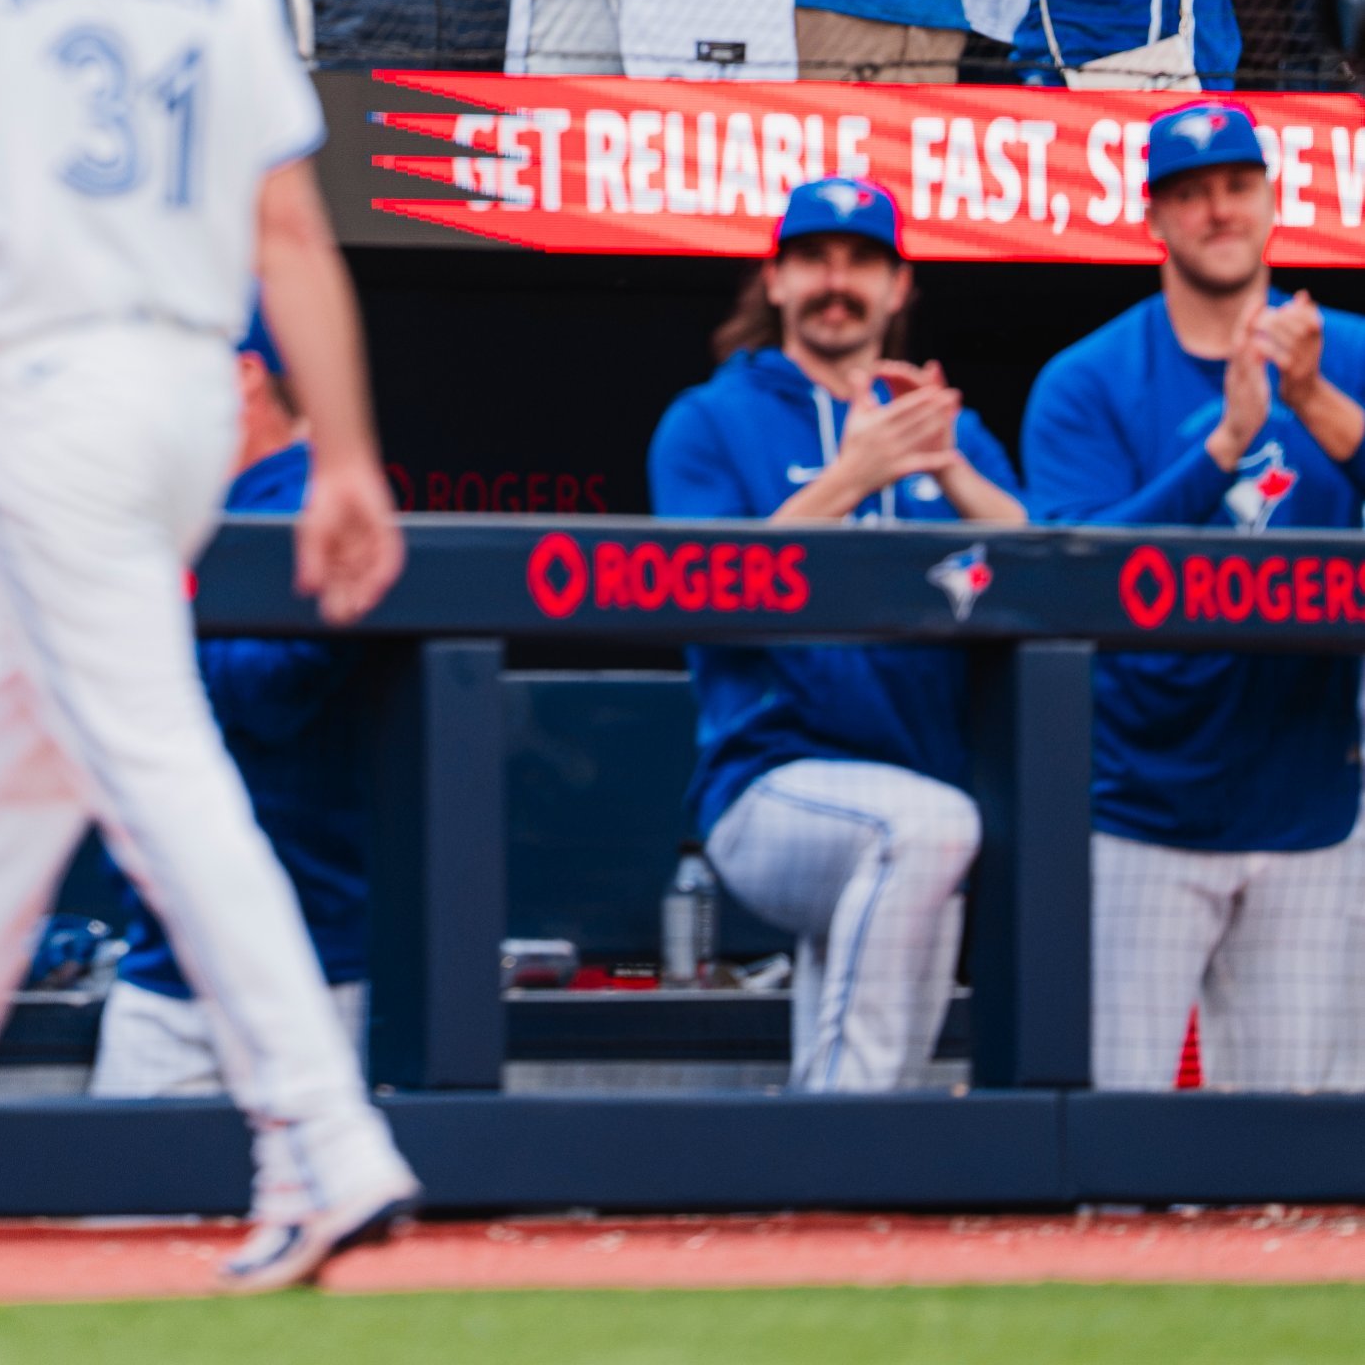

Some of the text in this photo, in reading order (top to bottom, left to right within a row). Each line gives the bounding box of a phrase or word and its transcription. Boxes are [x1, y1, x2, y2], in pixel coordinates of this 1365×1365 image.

[51, 26, 203, 210] 31
[910, 116, 1070, 234] FAST,
[594, 541, 811, 611] ROGERS
